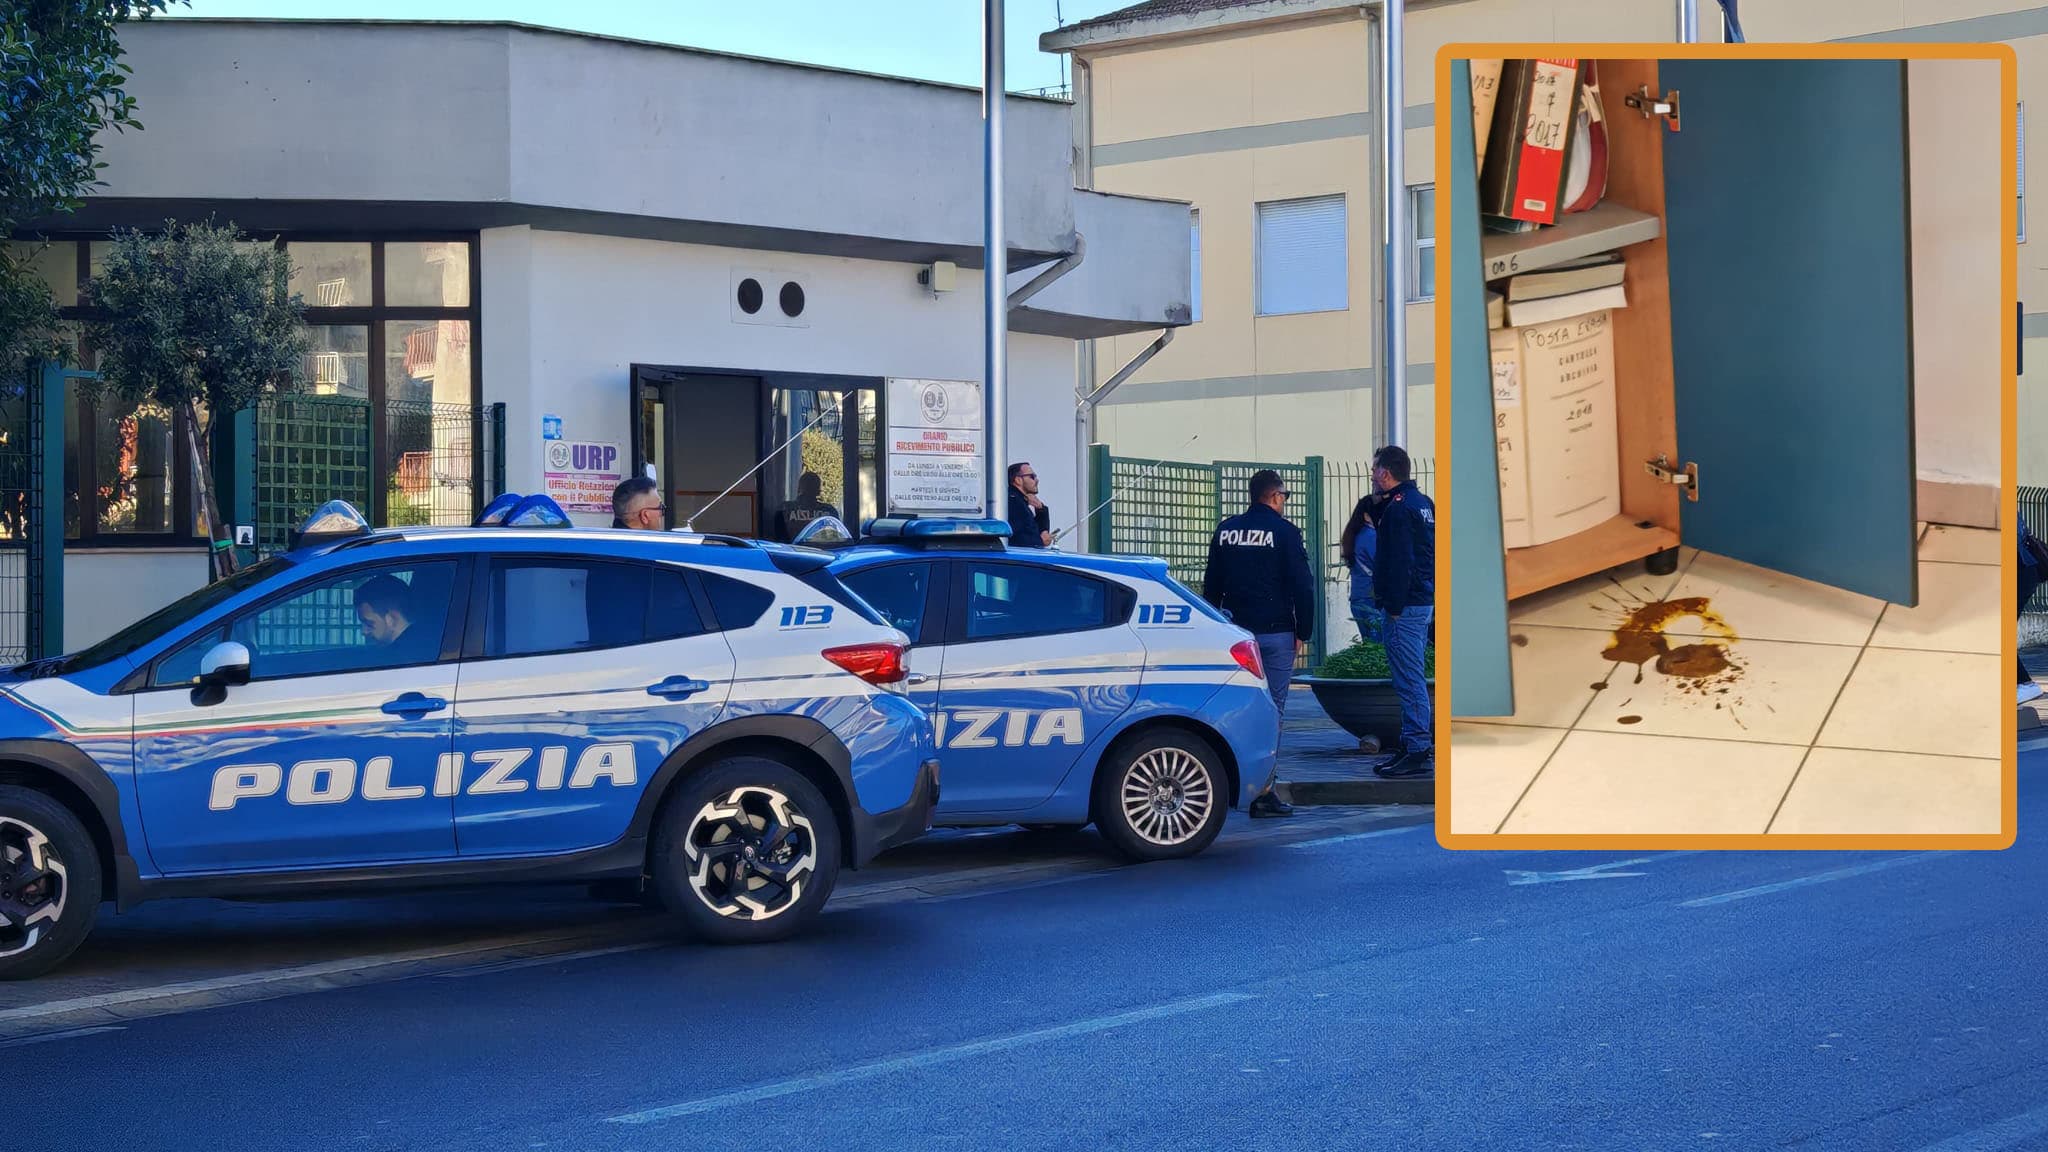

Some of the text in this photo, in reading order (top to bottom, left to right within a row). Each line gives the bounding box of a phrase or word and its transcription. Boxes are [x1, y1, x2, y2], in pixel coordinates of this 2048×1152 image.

[1522, 327, 1569, 349] POSTA
[572, 444, 617, 470] URP
[896, 441, 975, 453] RICEVIMENTO PUBBLICO
[548, 480, 576, 490] Ufficio
[1219, 529, 1275, 548] POLIZIA
[780, 605, 834, 625] 113
[1138, 604, 1192, 624] 113
[928, 708, 1085, 749] IZIA
[208, 742, 638, 811] POLIZIA
